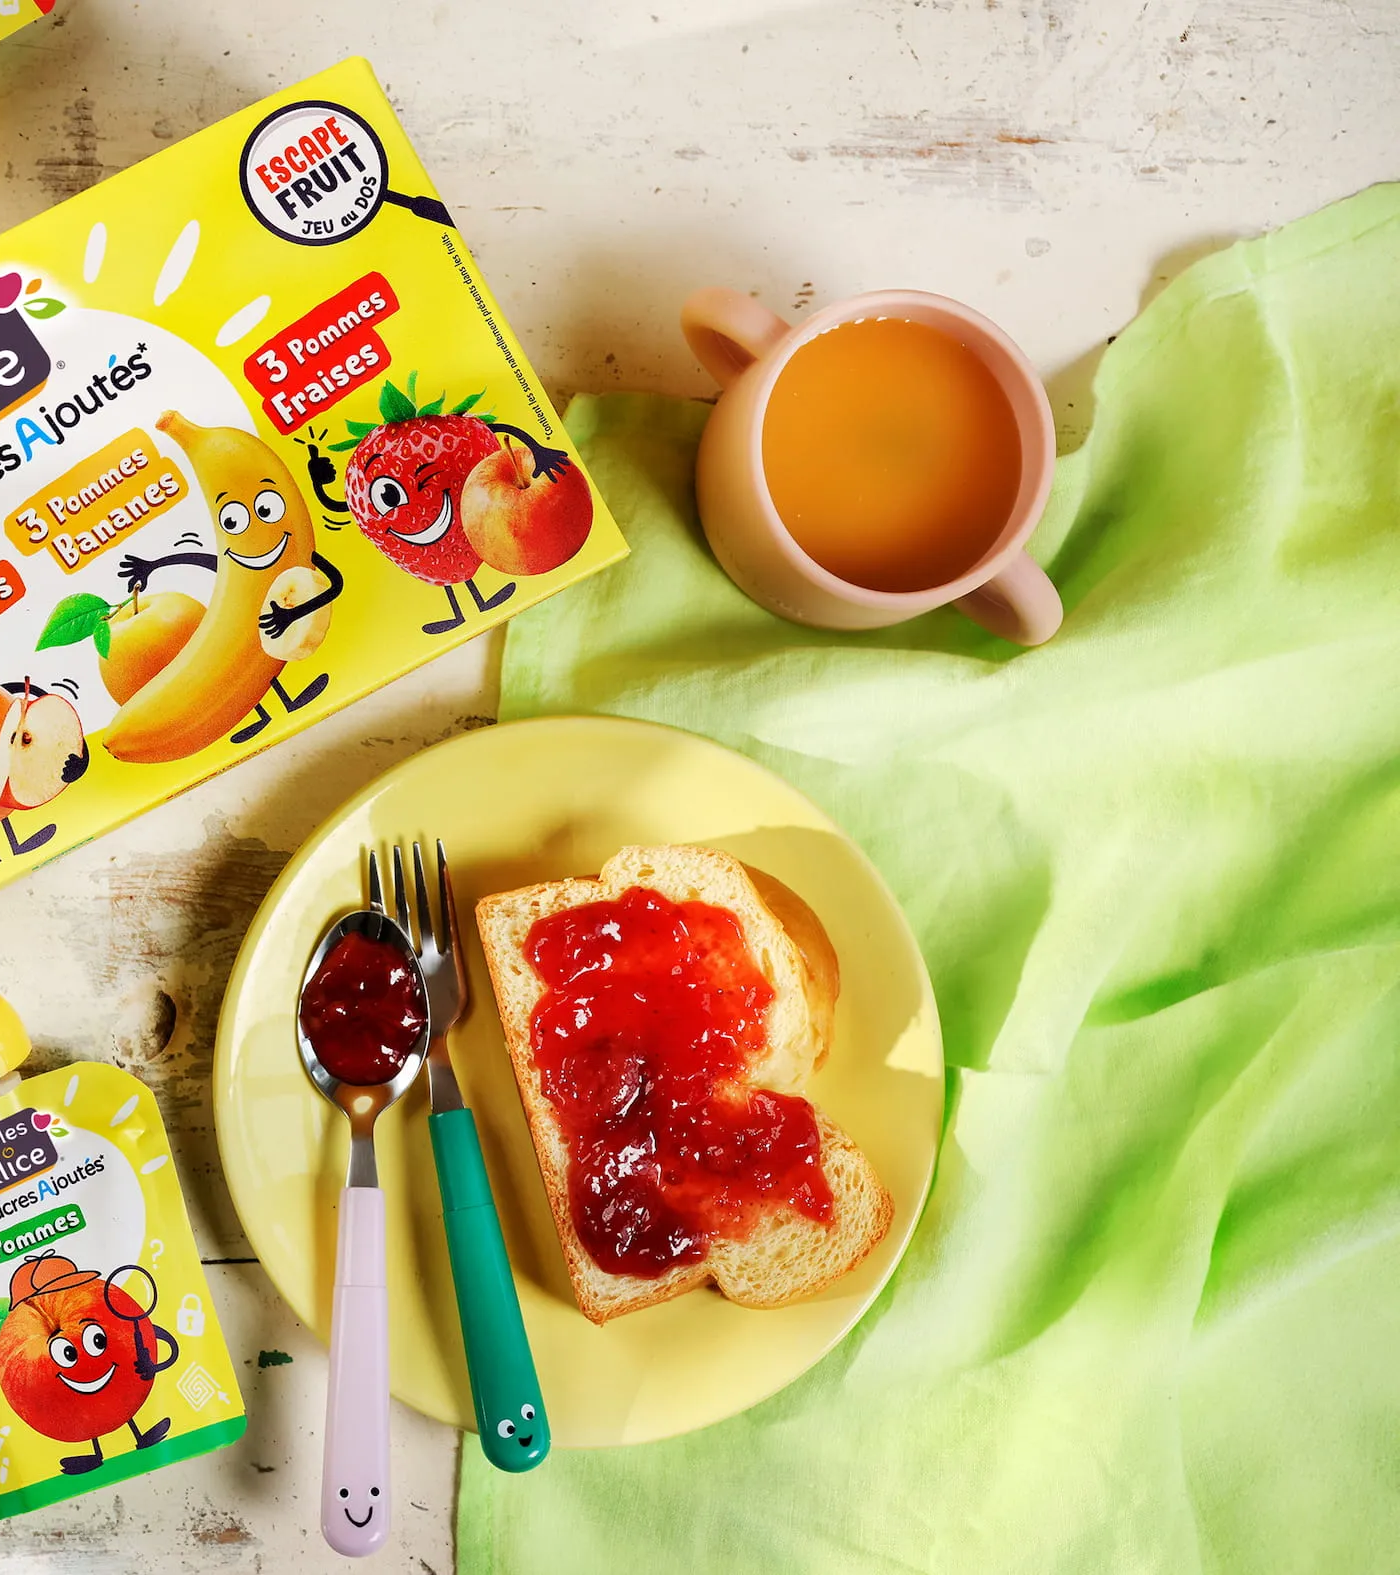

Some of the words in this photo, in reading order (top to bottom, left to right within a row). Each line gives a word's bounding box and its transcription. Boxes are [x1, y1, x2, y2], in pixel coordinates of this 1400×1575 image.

[255, 116, 349, 193] ESCAPE
[275, 142, 366, 220] FRUIT
[302, 219, 334, 235] JEU
[341, 210, 359, 227] au
[355, 176, 377, 209] DOS
[452, 254, 462, 268] les
[459, 266, 473, 285] dans
[468, 285, 492, 317] présents
[256, 349, 289, 384] 3
[287, 291, 387, 366] Pommes
[484, 317, 518, 369] naturellement
[271, 343, 380, 425] Fraises
[513, 368, 531, 393] sucres
[526, 392, 537, 406] les
[16, 507, 49, 543] 3
[47, 448, 148, 525] Pommes
[52, 472, 180, 569] Bananes
